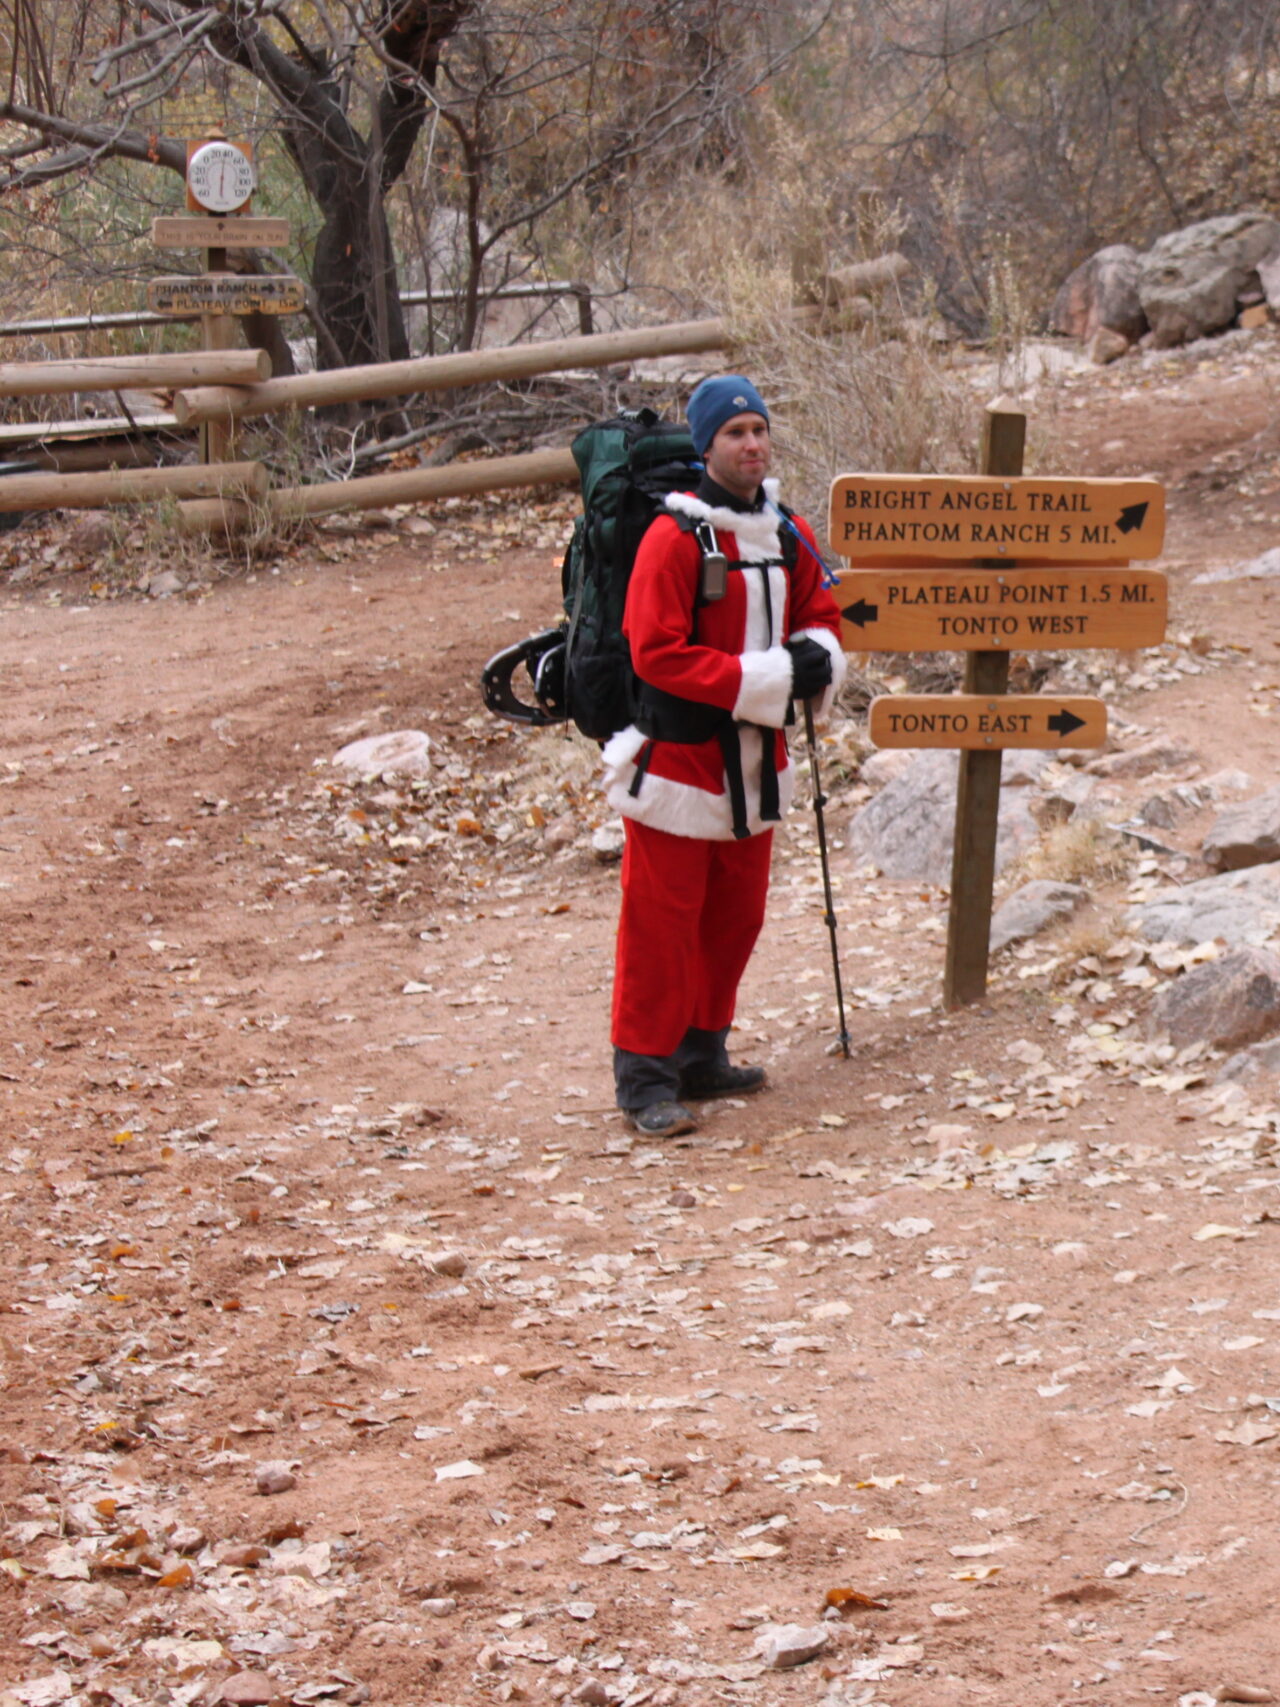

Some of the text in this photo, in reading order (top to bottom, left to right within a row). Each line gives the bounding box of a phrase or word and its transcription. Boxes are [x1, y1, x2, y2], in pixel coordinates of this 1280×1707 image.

[211, 150, 221, 158] 20
[223, 150, 233, 158] 40
[233, 157, 245, 165] 60
[161, 232, 181, 241] THIS
[199, 232, 221, 241] YOUR
[223, 232, 248, 241] BRAIN
[155, 284, 213, 294] PHANTOM
[217, 284, 257, 294] RANCH
[176, 299, 231, 309] PLATEAU
[235, 299, 266, 309] POINT
[844, 490, 1092, 512] BRIGHT ANGEL TRAIL
[843, 521, 1117, 544] PHANTOM RANCH 5 MI.
[887, 583, 1155, 605] PLATEAU POINT 1.5 MI.
[937, 615, 1089, 636] TONTO WEST
[888, 714, 1032, 733] TONTO EAST
